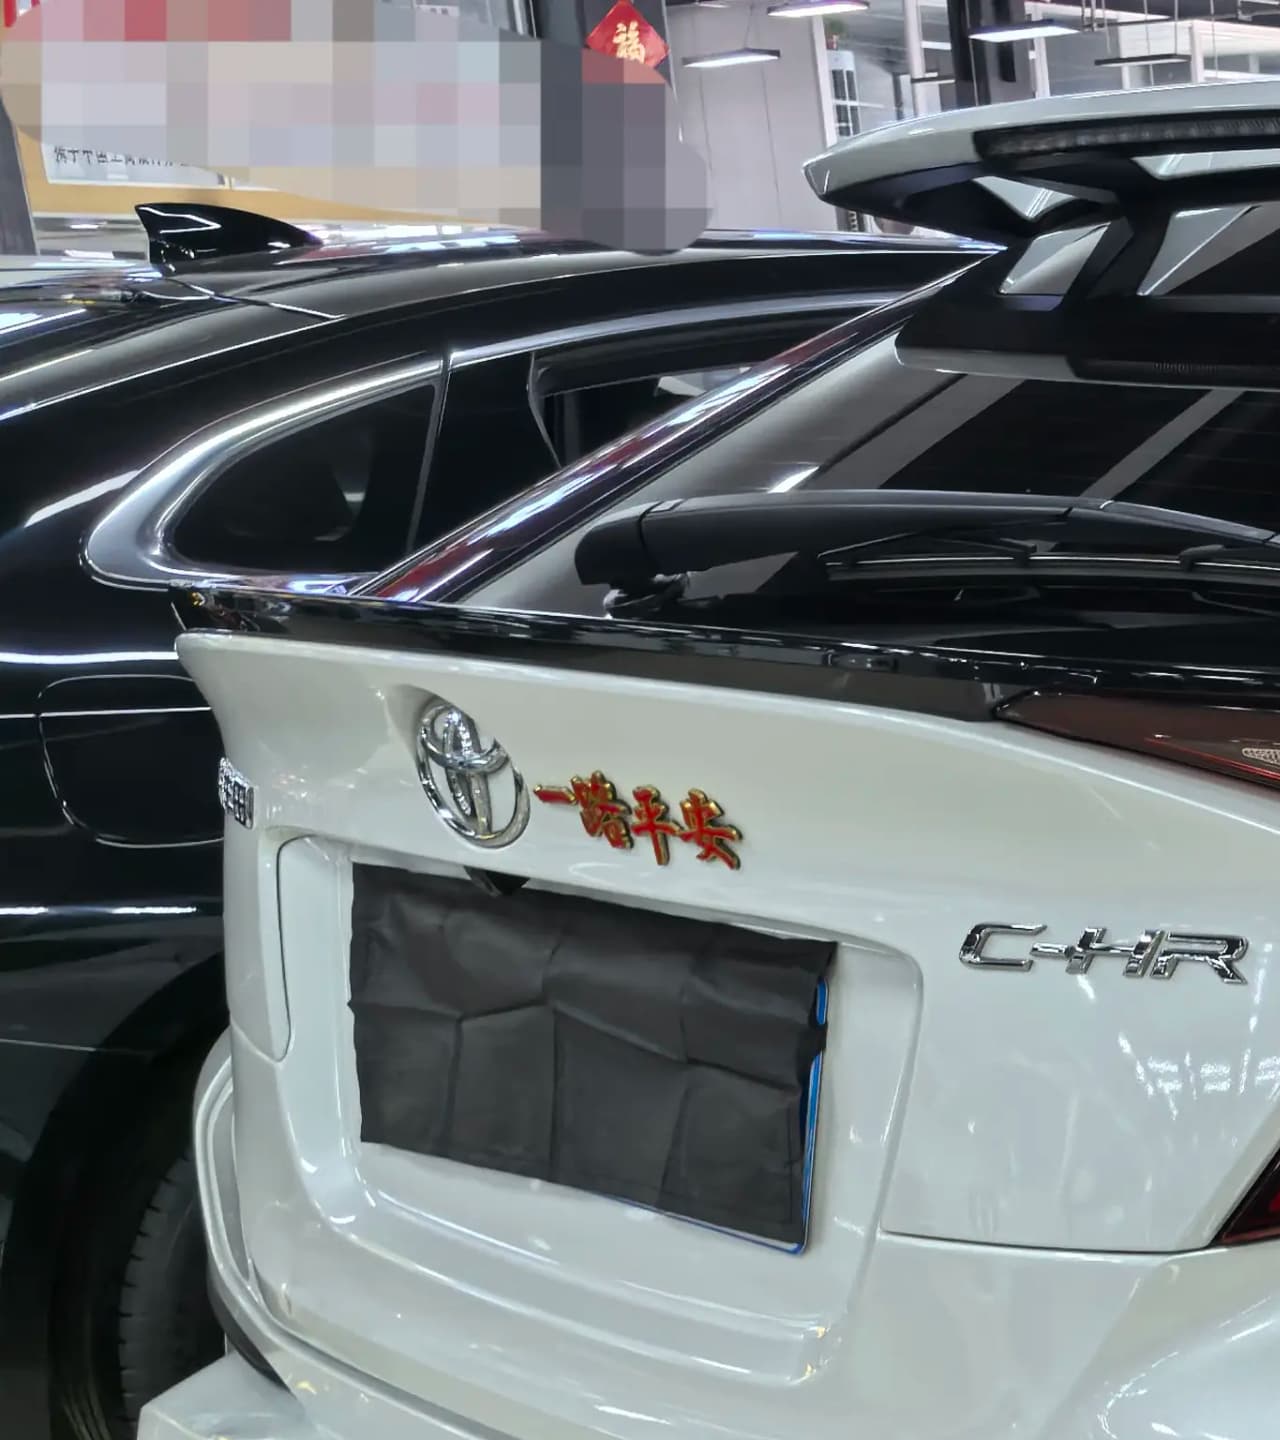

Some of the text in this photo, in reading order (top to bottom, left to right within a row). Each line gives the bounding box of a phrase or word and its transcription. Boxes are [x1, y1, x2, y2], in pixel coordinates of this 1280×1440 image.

[534, 770, 743, 869] 一路平安
[959, 922, 1249, 985] C-HR
